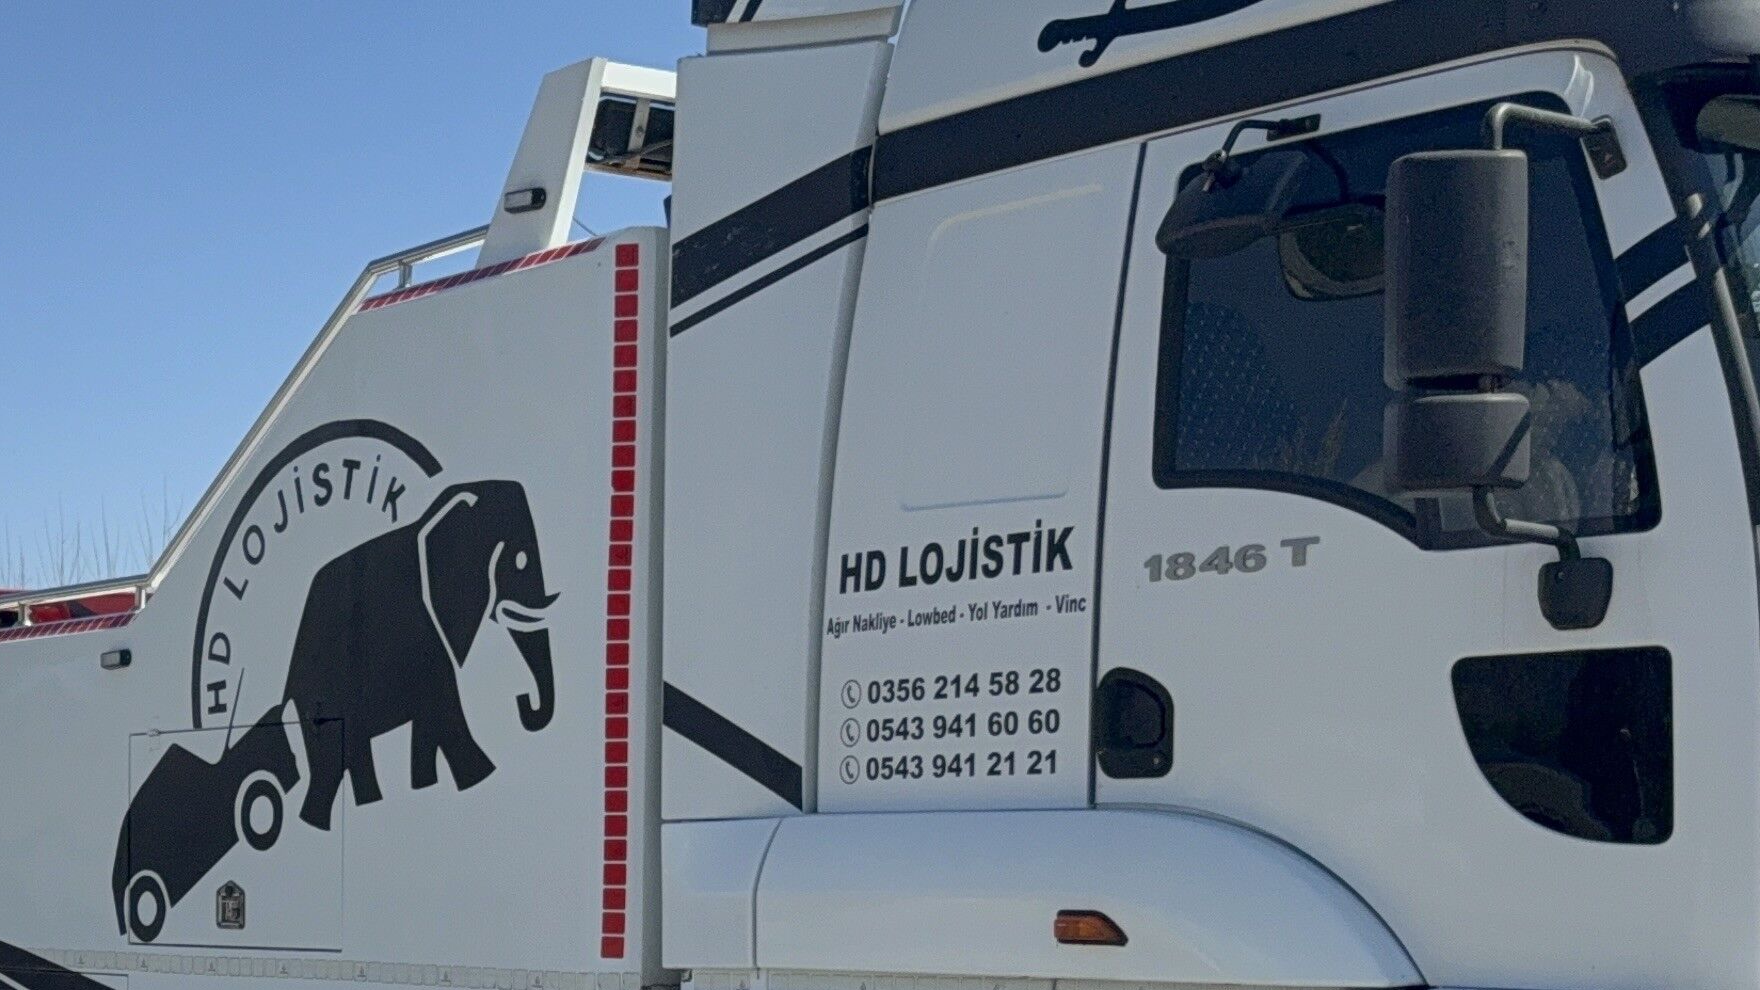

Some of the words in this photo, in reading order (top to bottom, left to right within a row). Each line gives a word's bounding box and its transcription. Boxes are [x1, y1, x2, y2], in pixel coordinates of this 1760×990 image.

[839, 550, 886, 595] HD
[898, 518, 1075, 588] LOJİSTİK
[1144, 543, 1268, 582] 1846
[1280, 536, 1321, 567] T
[207, 631, 232, 715] HD
[223, 454, 406, 601] LOJİSTİK
[827, 616, 850, 639] Ağır
[852, 612, 897, 635] Nakliye
[907, 605, 956, 627] Lowbed
[968, 601, 988, 621] Yol
[992, 599, 1039, 619] Yardım
[1055, 594, 1086, 614] Vinc
[867, 677, 925, 704] 0356
[933, 673, 980, 699] 214
[989, 670, 1020, 696] 58
[1028, 668, 1061, 694] 28
[866, 716, 924, 742] 0543
[932, 712, 976, 739] 941
[988, 710, 1019, 736] 60
[1028, 709, 1060, 734] 60
[865, 755, 924, 781] 0543
[932, 753, 976, 778] 941
[987, 751, 1015, 776] 21
[1027, 749, 1057, 775] 21
